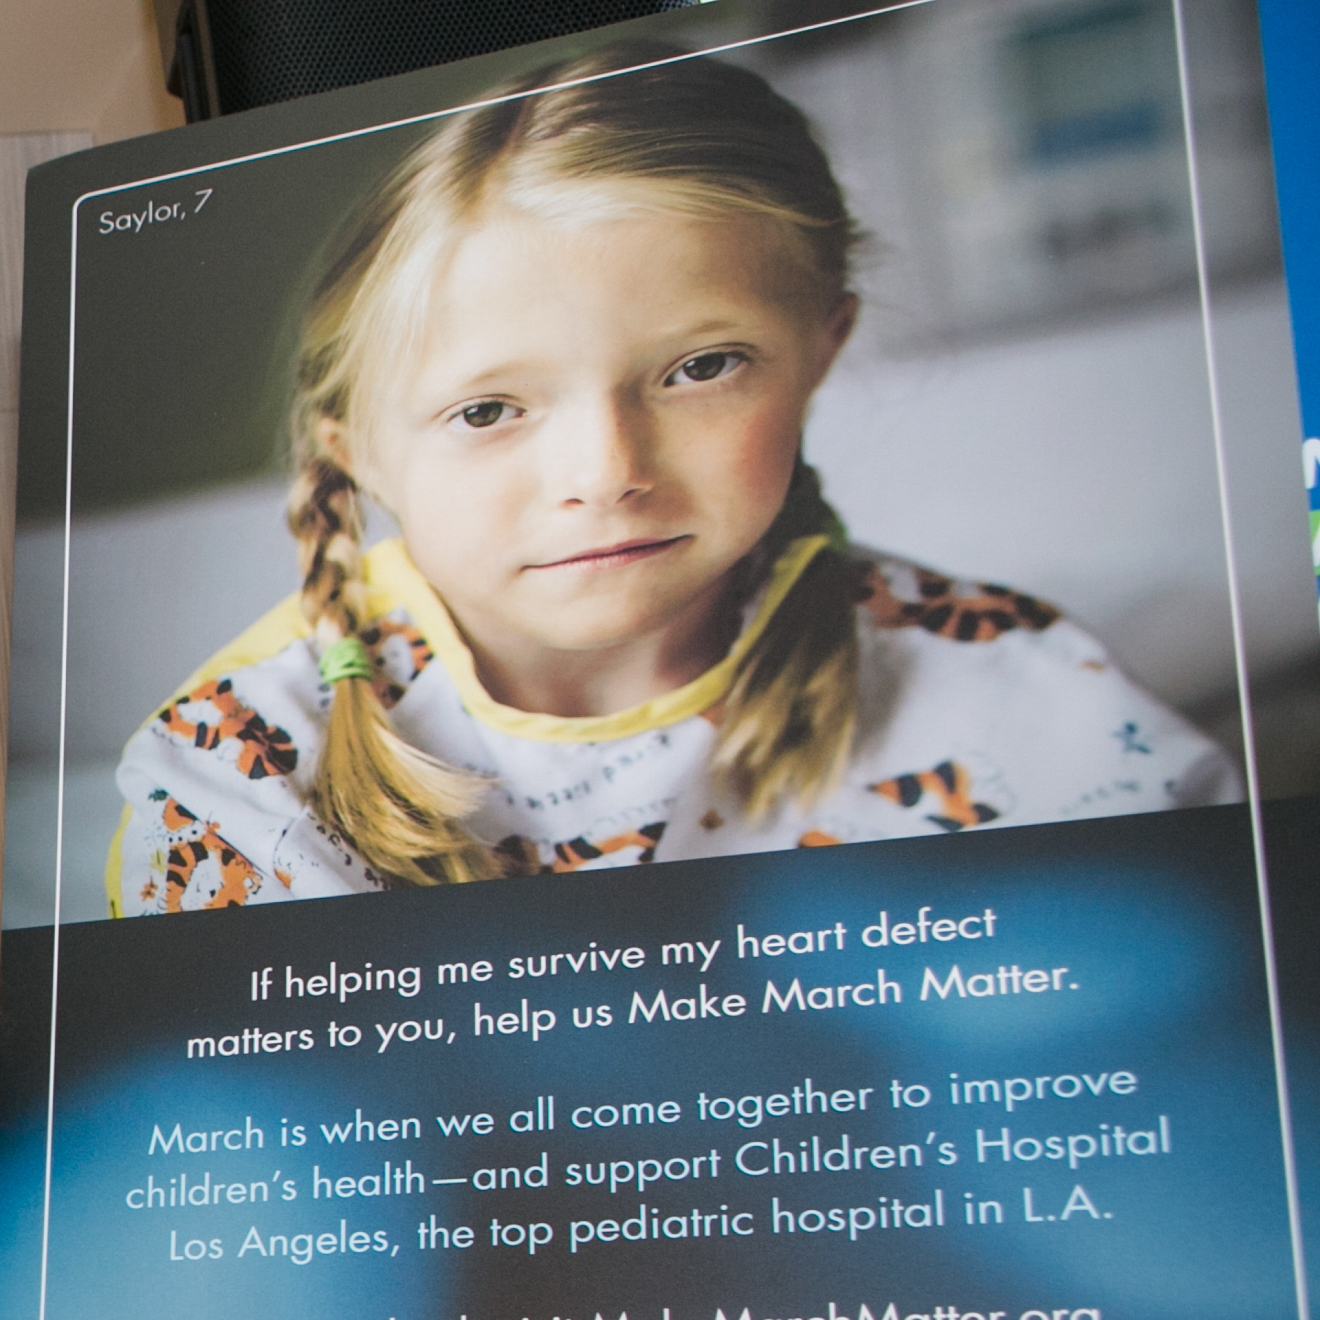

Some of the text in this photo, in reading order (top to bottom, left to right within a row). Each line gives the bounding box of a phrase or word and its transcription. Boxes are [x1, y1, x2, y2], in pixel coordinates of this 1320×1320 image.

[99, 188, 213, 234] Saylor, 7
[252, 906, 998, 1003] If helping me survive my heart defect
[187, 964, 1080, 1058] matters to you, help us Make March Matter.
[148, 1071, 1138, 1155] March is when we all come together to improve
[126, 1170, 297, 1208] children's
[566, 1149, 721, 1193] support
[736, 1131, 959, 1175] Children's
[976, 1115, 1170, 1169] Hospital
[171, 1184, 1113, 1265] Los Angeles, the top pediatric hospital in L.A.
